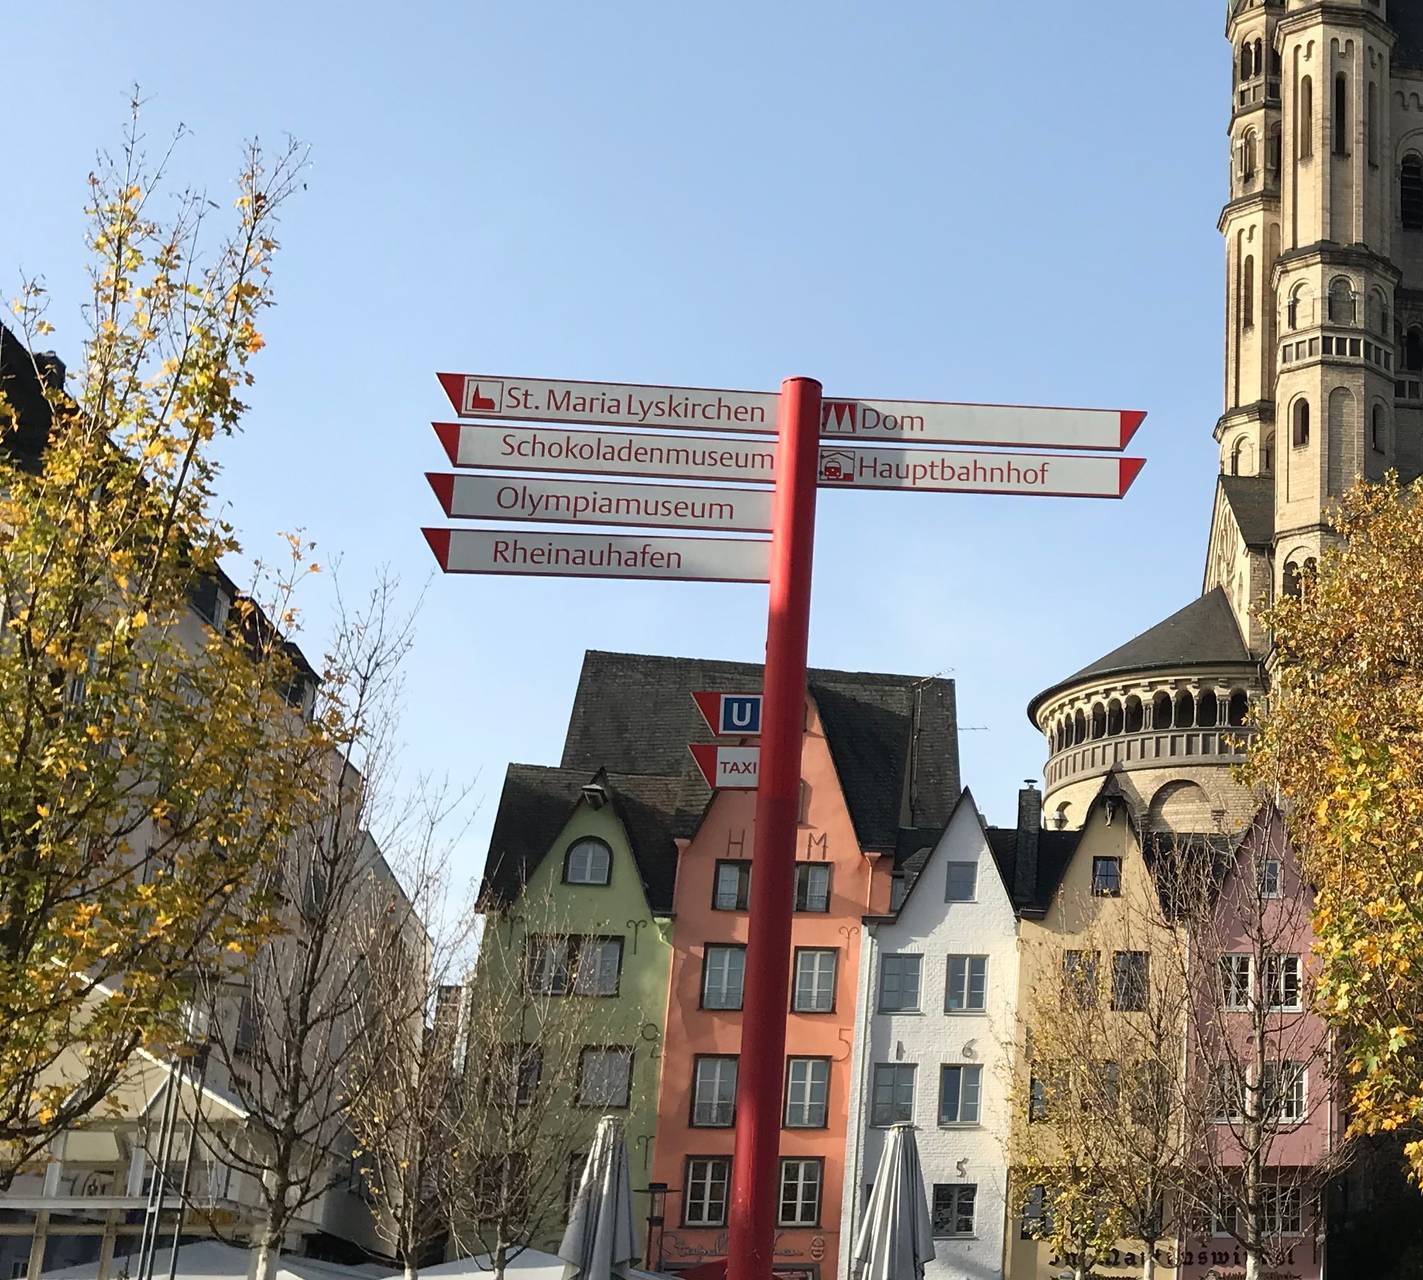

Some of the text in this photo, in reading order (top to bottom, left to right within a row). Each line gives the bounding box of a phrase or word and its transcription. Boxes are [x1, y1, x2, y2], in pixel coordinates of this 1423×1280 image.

[505, 386, 766, 424] St. Maria Lyskirchen
[861, 408, 925, 433] Dom
[501, 433, 775, 471] Schokoladenmuseum
[858, 456, 1050, 486] Hauptbahnhof
[496, 485, 735, 521] Olympiamuseum
[492, 539, 683, 570] Rheinauhafen
[732, 702, 752, 727] U
[720, 761, 757, 775] TAXI
[726, 827, 746, 858] H
